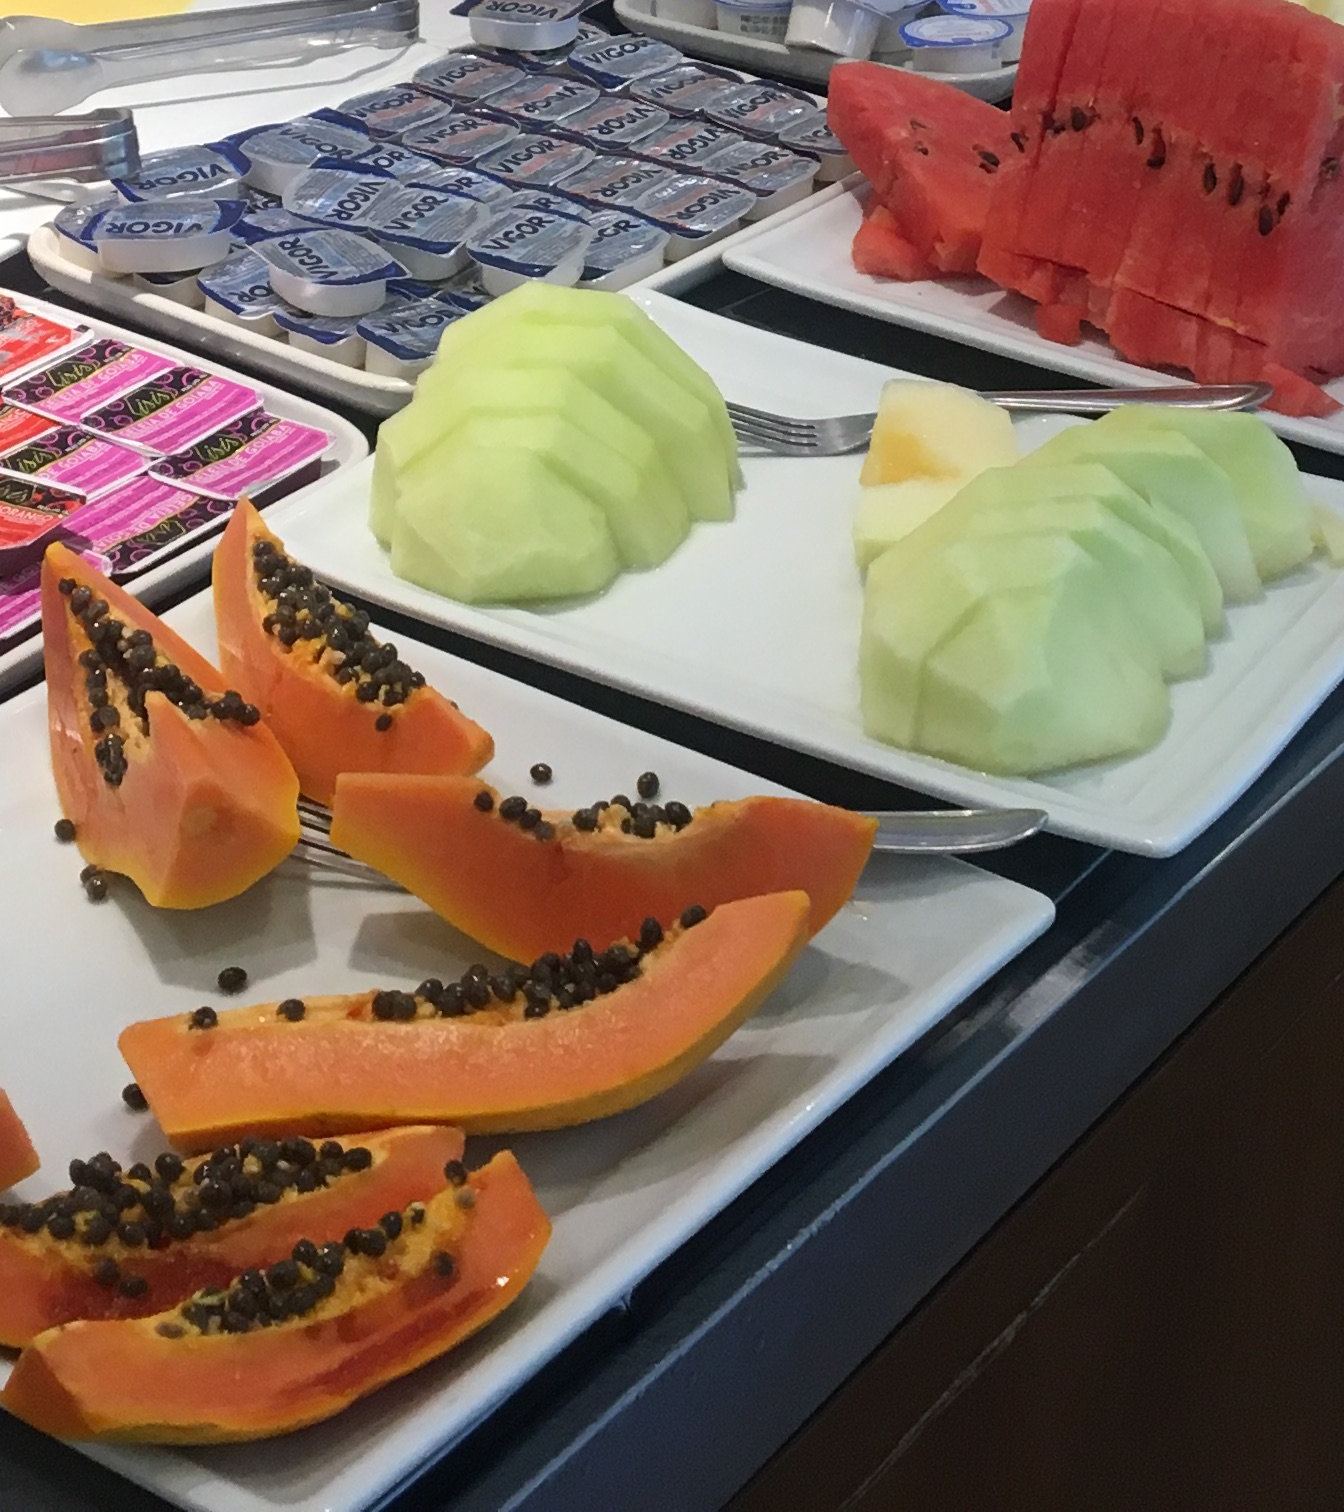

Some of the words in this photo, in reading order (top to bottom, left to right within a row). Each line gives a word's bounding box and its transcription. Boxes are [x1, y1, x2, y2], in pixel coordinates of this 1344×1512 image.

[486, 0, 558, 19] VIGOR
[348, 91, 422, 119] VIGOR
[718, 89, 785, 118] VIGOR
[417, 118, 487, 144] VIGOR
[589, 108, 655, 134] VIGOR
[279, 128, 353, 161] VIGOR
[491, 139, 567, 173] VIGOR
[663, 124, 727, 160] VIGOR
[134, 163, 228, 189] VIGOR
[590, 168, 661, 198] VIGOR
[326, 181, 386, 220] VIGOR
[383, 196, 449, 231] VIGOR
[666, 188, 741, 220] VIGOR
[106, 221, 203, 234] VIGOR
[482, 215, 555, 251] VIGOR
[278, 238, 338, 279] VIGOR
[135, 390, 169, 417] isis
